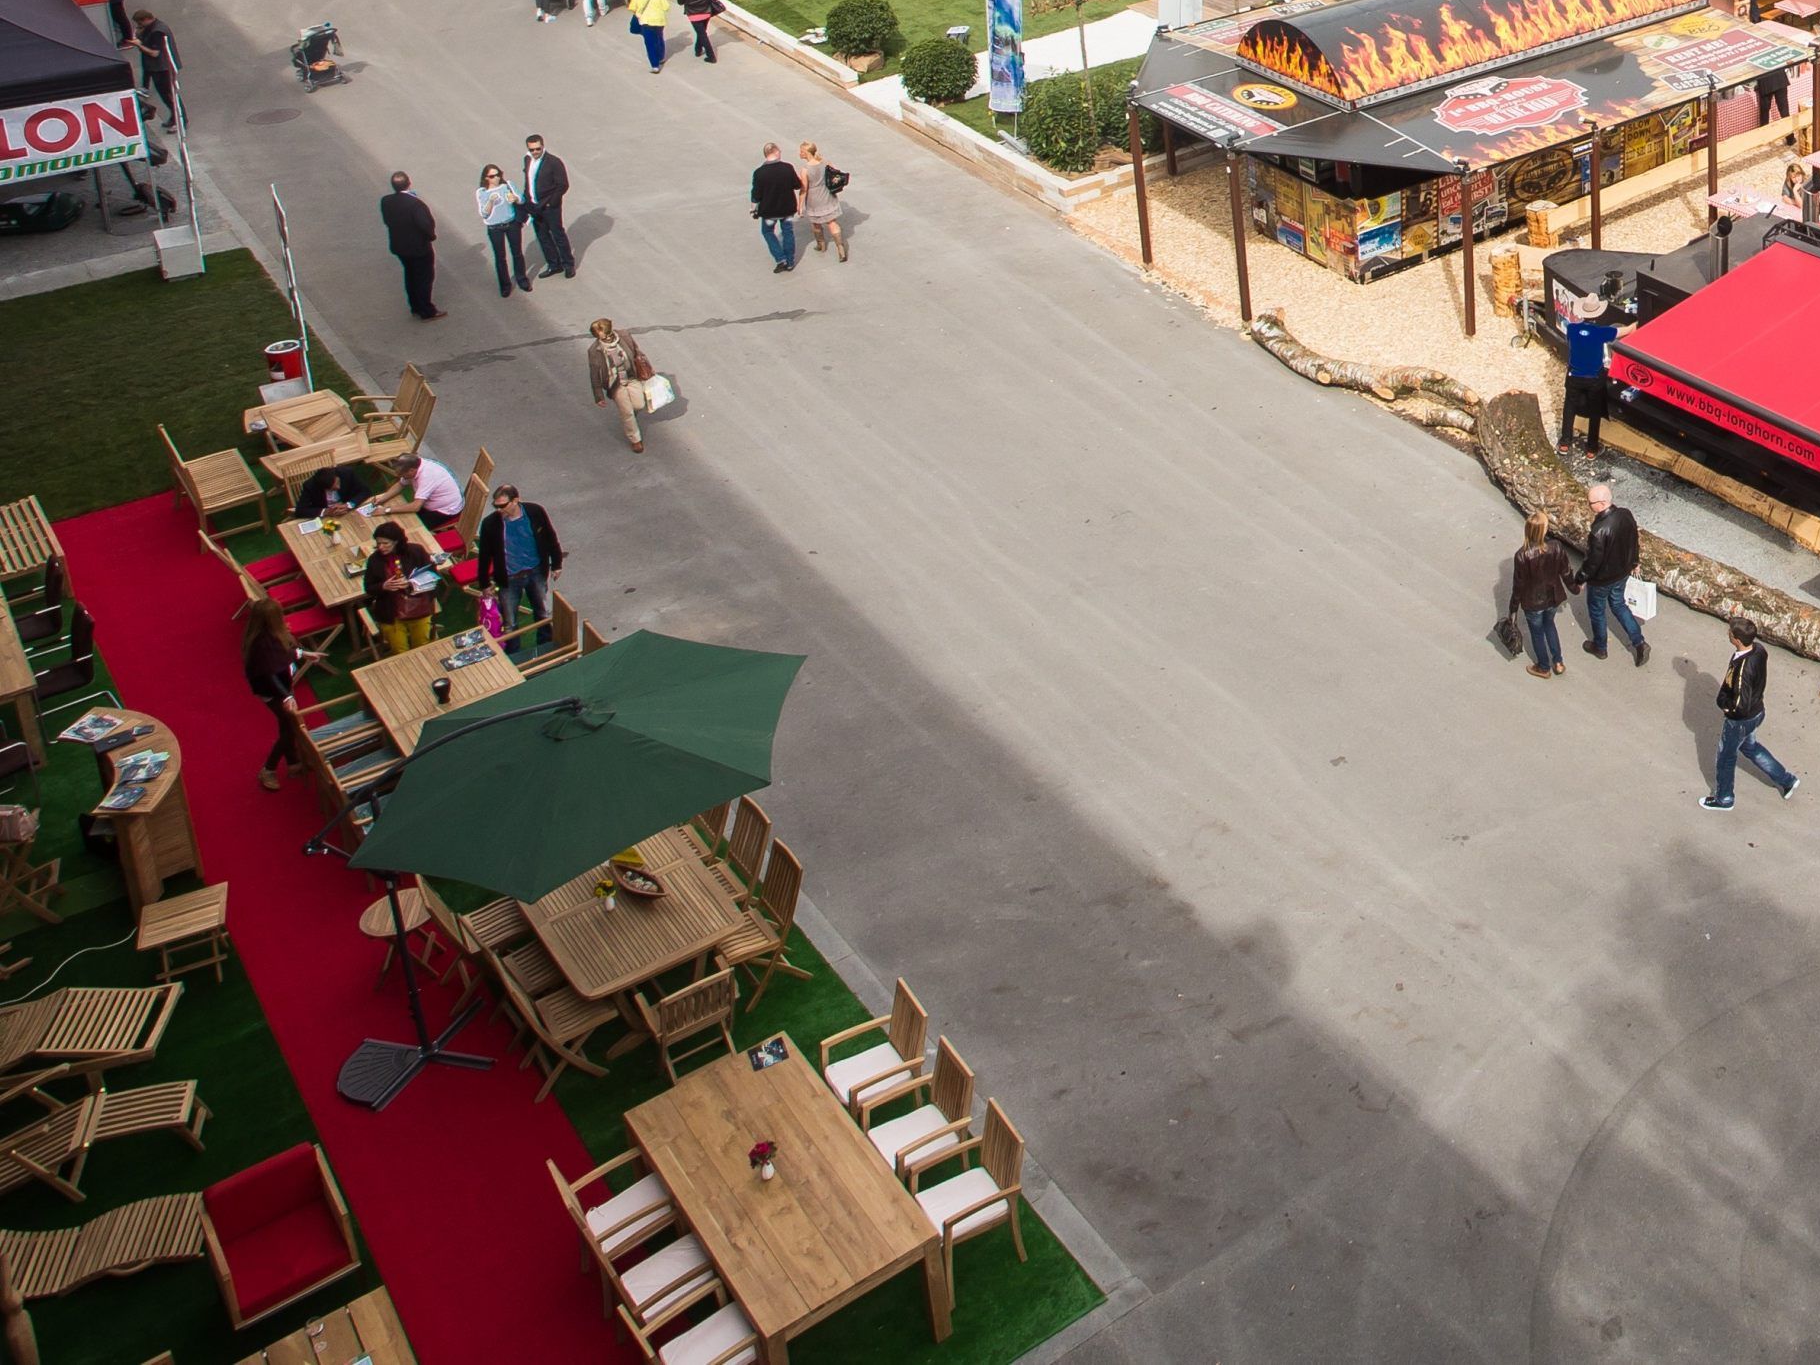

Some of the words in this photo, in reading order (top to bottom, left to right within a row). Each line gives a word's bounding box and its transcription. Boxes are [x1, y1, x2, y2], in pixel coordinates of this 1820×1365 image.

[1665, 46, 1701, 64] RENT
[1465, 83, 1550, 112] BBQ-HOUSE
[1204, 98, 1260, 128] CATERING
[1502, 104, 1528, 118] THE
[0, 96, 140, 161] LON
[1627, 128, 1652, 141] DOWN
[1628, 118, 1651, 131] SLOW
[1666, 384, 1815, 462] www.bbq-longhorn.com
